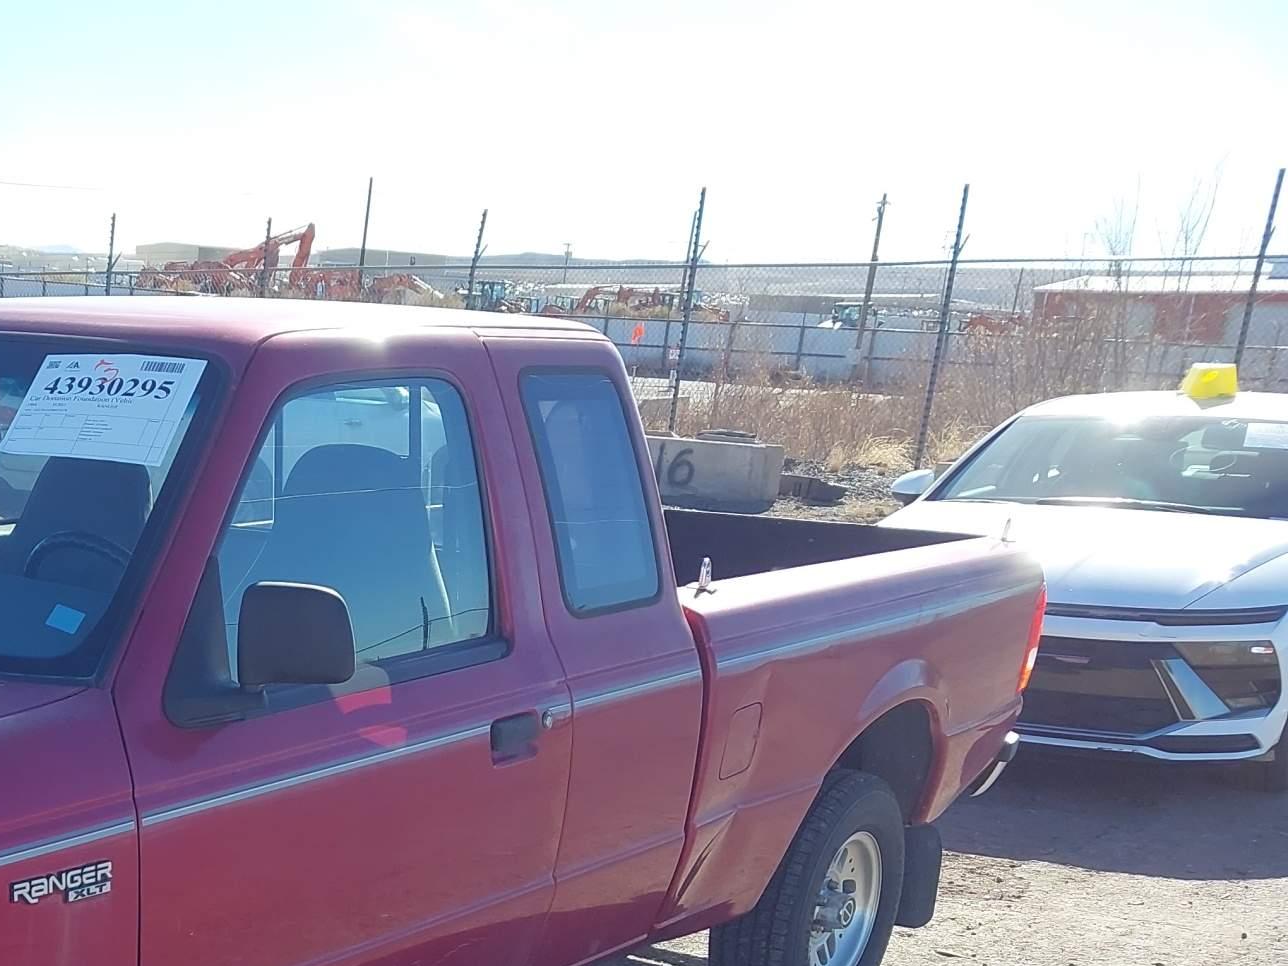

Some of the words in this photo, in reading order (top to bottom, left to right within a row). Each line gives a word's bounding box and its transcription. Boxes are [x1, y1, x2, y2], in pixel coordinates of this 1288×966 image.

[44, 376, 175, 399] 43930295
[13, 861, 113, 904] RANGER
[72, 882, 110, 901] XLT
